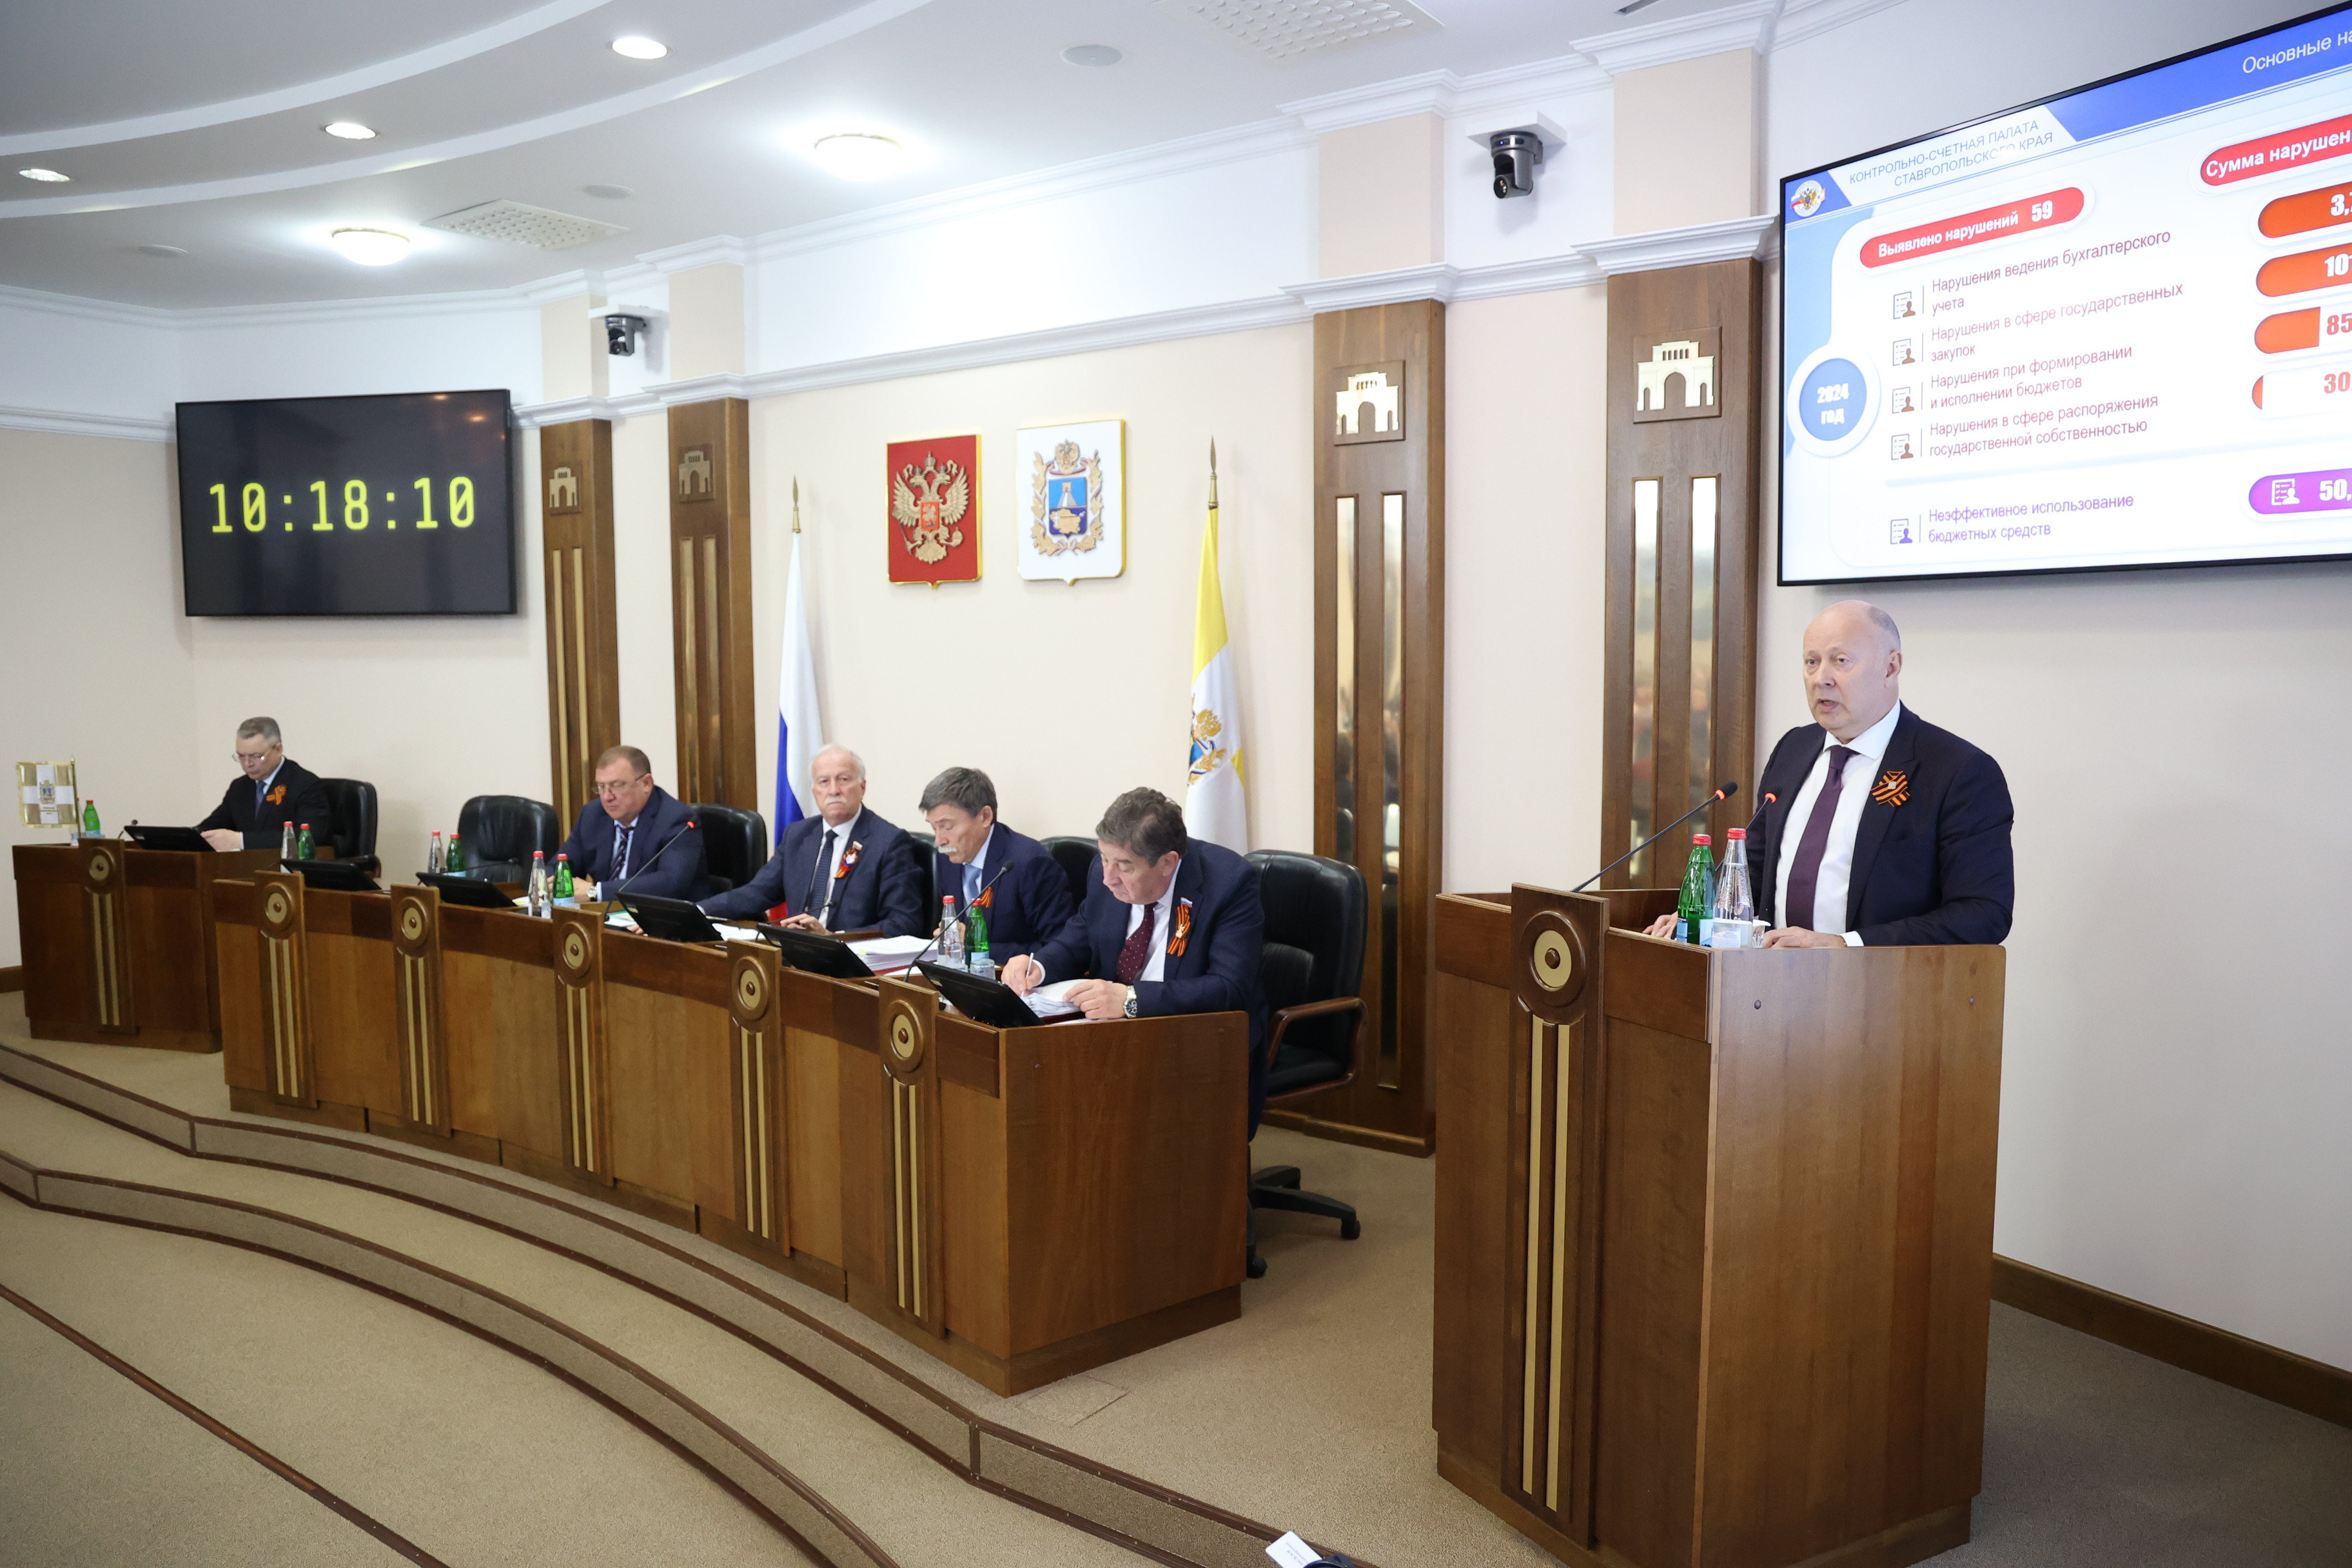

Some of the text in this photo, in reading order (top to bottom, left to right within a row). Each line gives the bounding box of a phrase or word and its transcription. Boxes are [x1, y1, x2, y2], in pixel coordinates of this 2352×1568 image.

[2242, 37, 2332, 74] Основные
[1849, 120, 2039, 184] КОНТРОЛЬНО-СЧЕТНАЯ ПАЛАТА
[2019, 132, 2053, 150] КРАЯ
[2206, 152, 2264, 179] Сумма
[2330, 191, 2352, 216] 3,
[1878, 200, 2053, 258] Выявлено нарушений 59
[1932, 231, 2171, 293] Нарушения ведения бухгалтерского
[1932, 297, 1965, 317] учета
[1932, 284, 2184, 342] Нарушения в сфере государственных
[1931, 344, 1976, 363] закупок
[1931, 346, 2133, 389] Нарушения при формировании
[1817, 383, 1850, 404] 2024
[1931, 377, 2082, 409] и исполнении бюджетов
[2324, 371, 2352, 394] 30
[1821, 408, 1845, 425] год
[1930, 396, 2159, 437] Нарушения в сфере распоряжения
[1930, 420, 2148, 458] государственной собственностью
[209, 476, 475, 533] 10:18:10
[1929, 496, 2134, 524] Неэффективное использование
[1928, 524, 2051, 544] бюджетных средств
